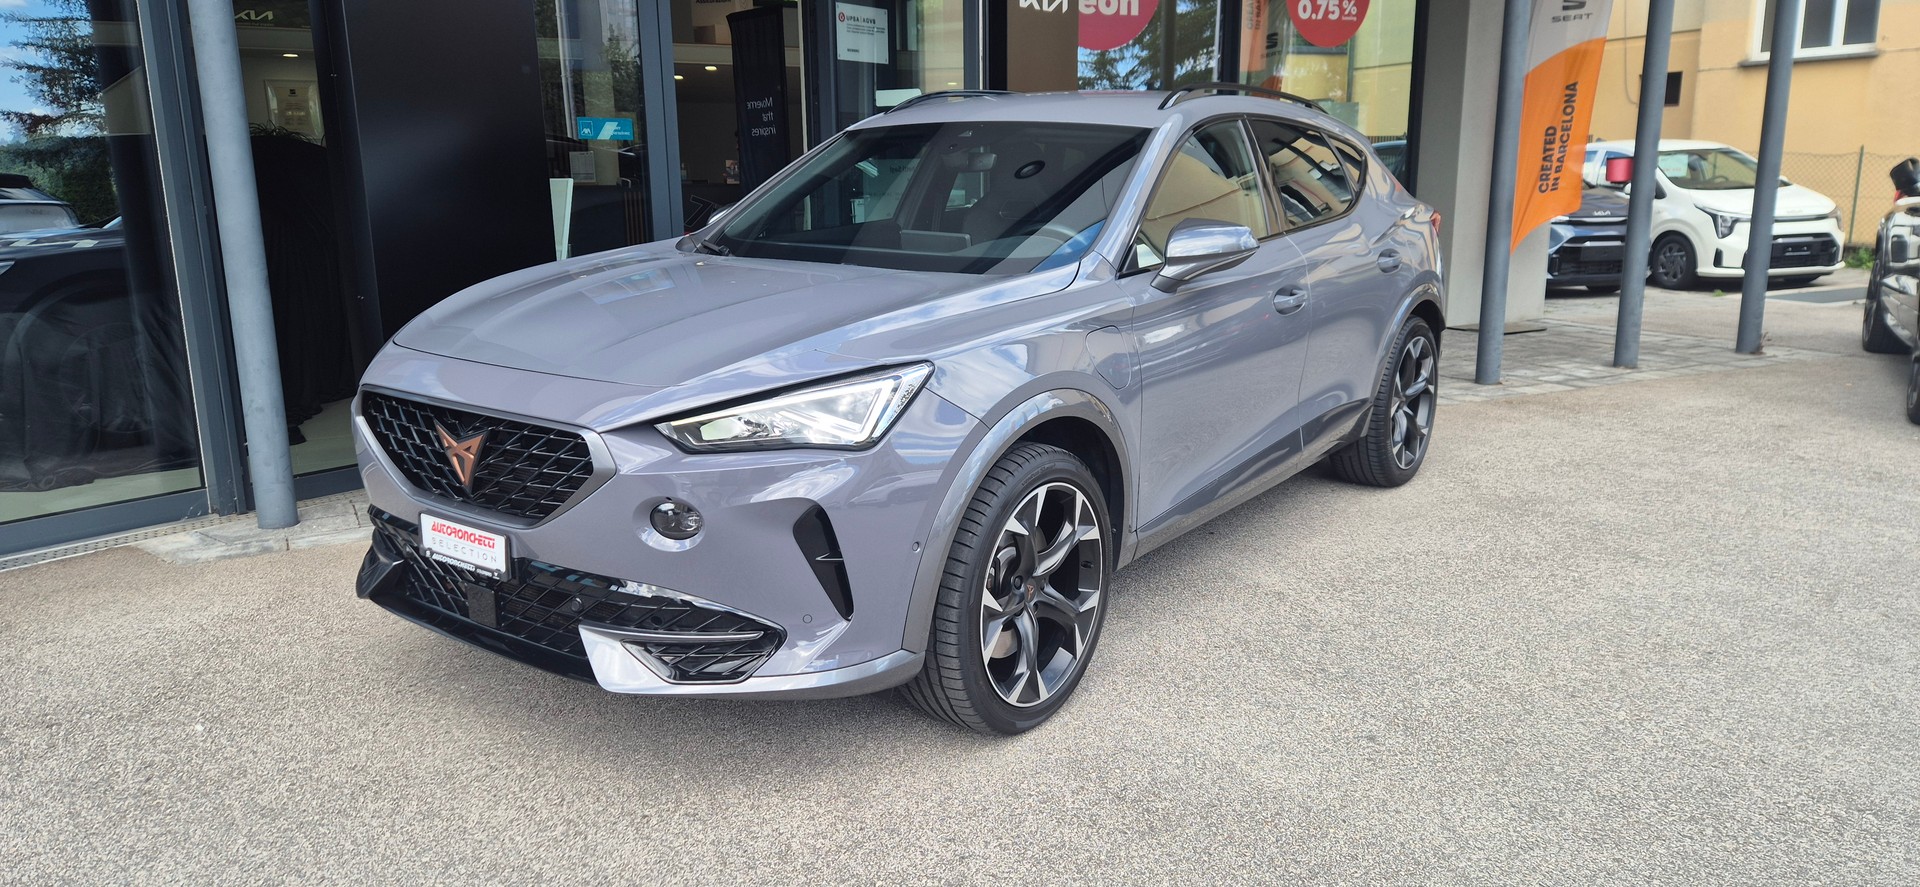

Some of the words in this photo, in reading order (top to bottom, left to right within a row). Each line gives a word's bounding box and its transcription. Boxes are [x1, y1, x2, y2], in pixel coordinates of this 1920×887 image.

[1078, 0, 1140, 16] eon
[1551, 12, 1594, 24] SEAT
[1554, 80, 1579, 175] BARCELONA
[1538, 125, 1558, 194] CREATED
[1550, 176, 1561, 192] IN
[432, 537, 497, 563] SELECTION
